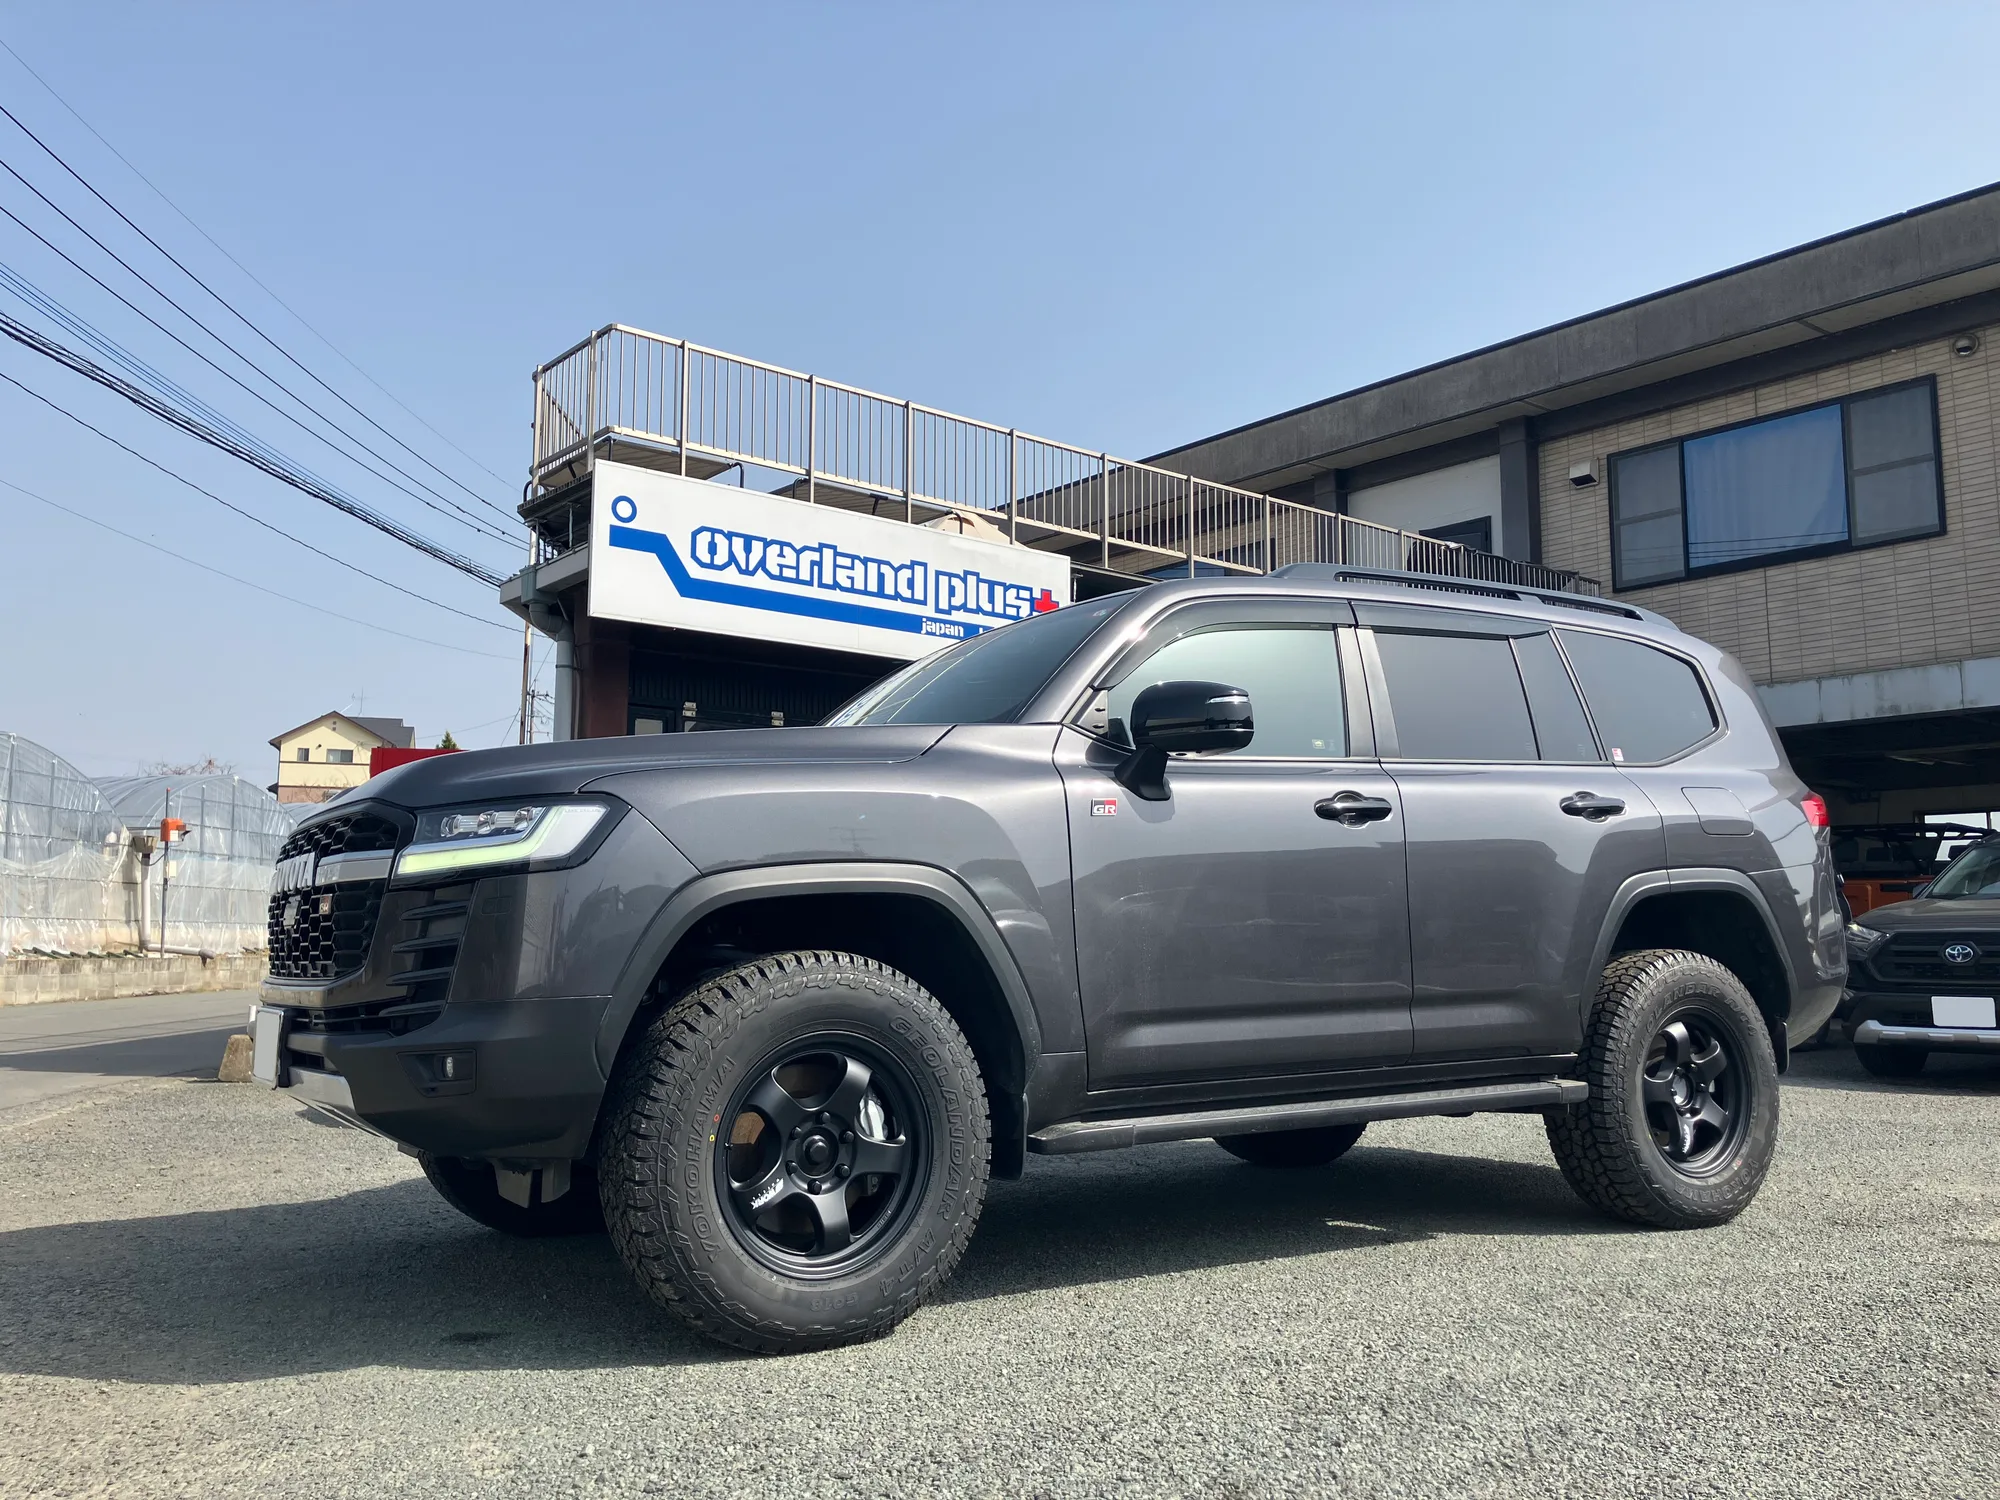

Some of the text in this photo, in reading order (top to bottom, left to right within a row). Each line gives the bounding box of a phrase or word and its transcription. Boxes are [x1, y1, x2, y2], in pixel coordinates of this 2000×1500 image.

[691, 526, 927, 606] overland
[921, 618, 964, 637] japan
[1093, 803, 1117, 815] GR
[889, 1016, 964, 1220] GEOLANDAR
[684, 1055, 737, 1263] YOKOHAMA
